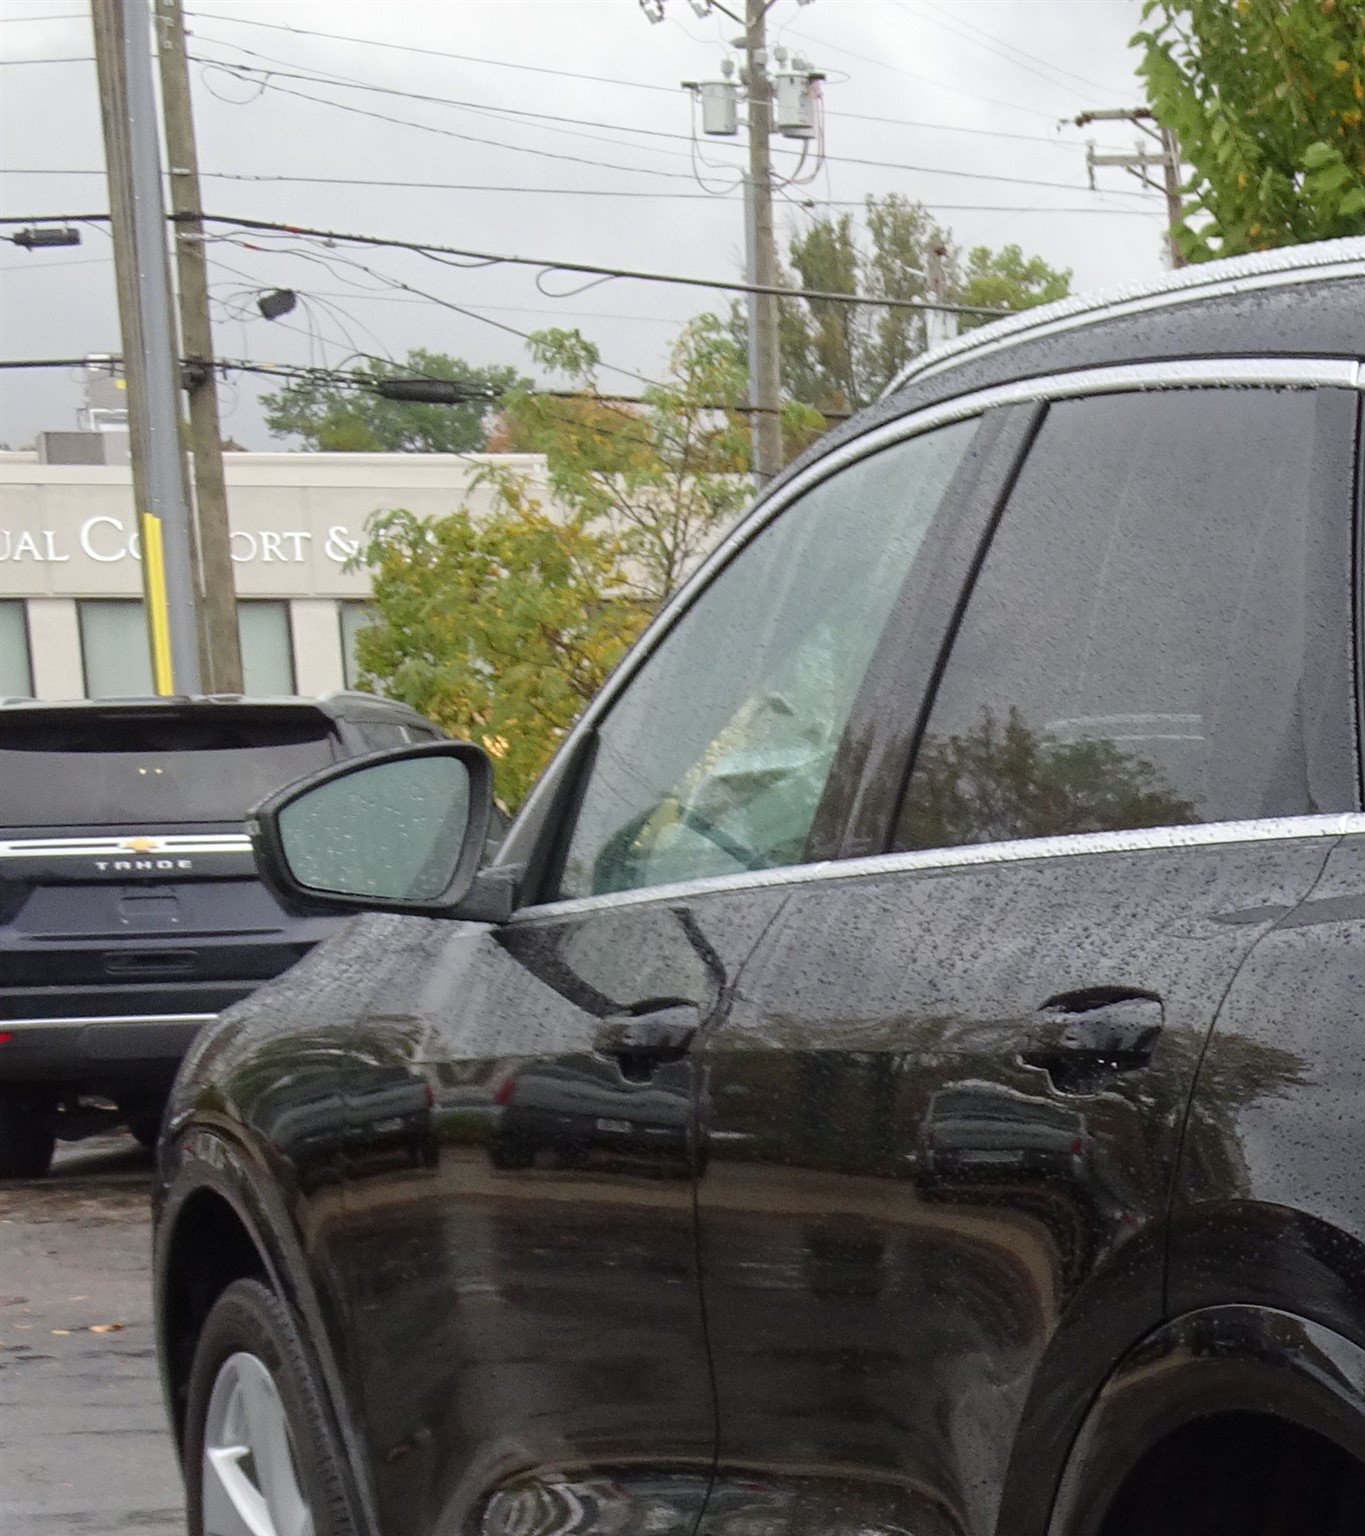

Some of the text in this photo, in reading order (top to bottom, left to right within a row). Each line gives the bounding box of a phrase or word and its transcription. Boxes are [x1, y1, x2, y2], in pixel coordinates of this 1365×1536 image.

[80, 516, 312, 562] CORT
[324, 526, 358, 562] &
[95, 860, 193, 871] TAHOE
